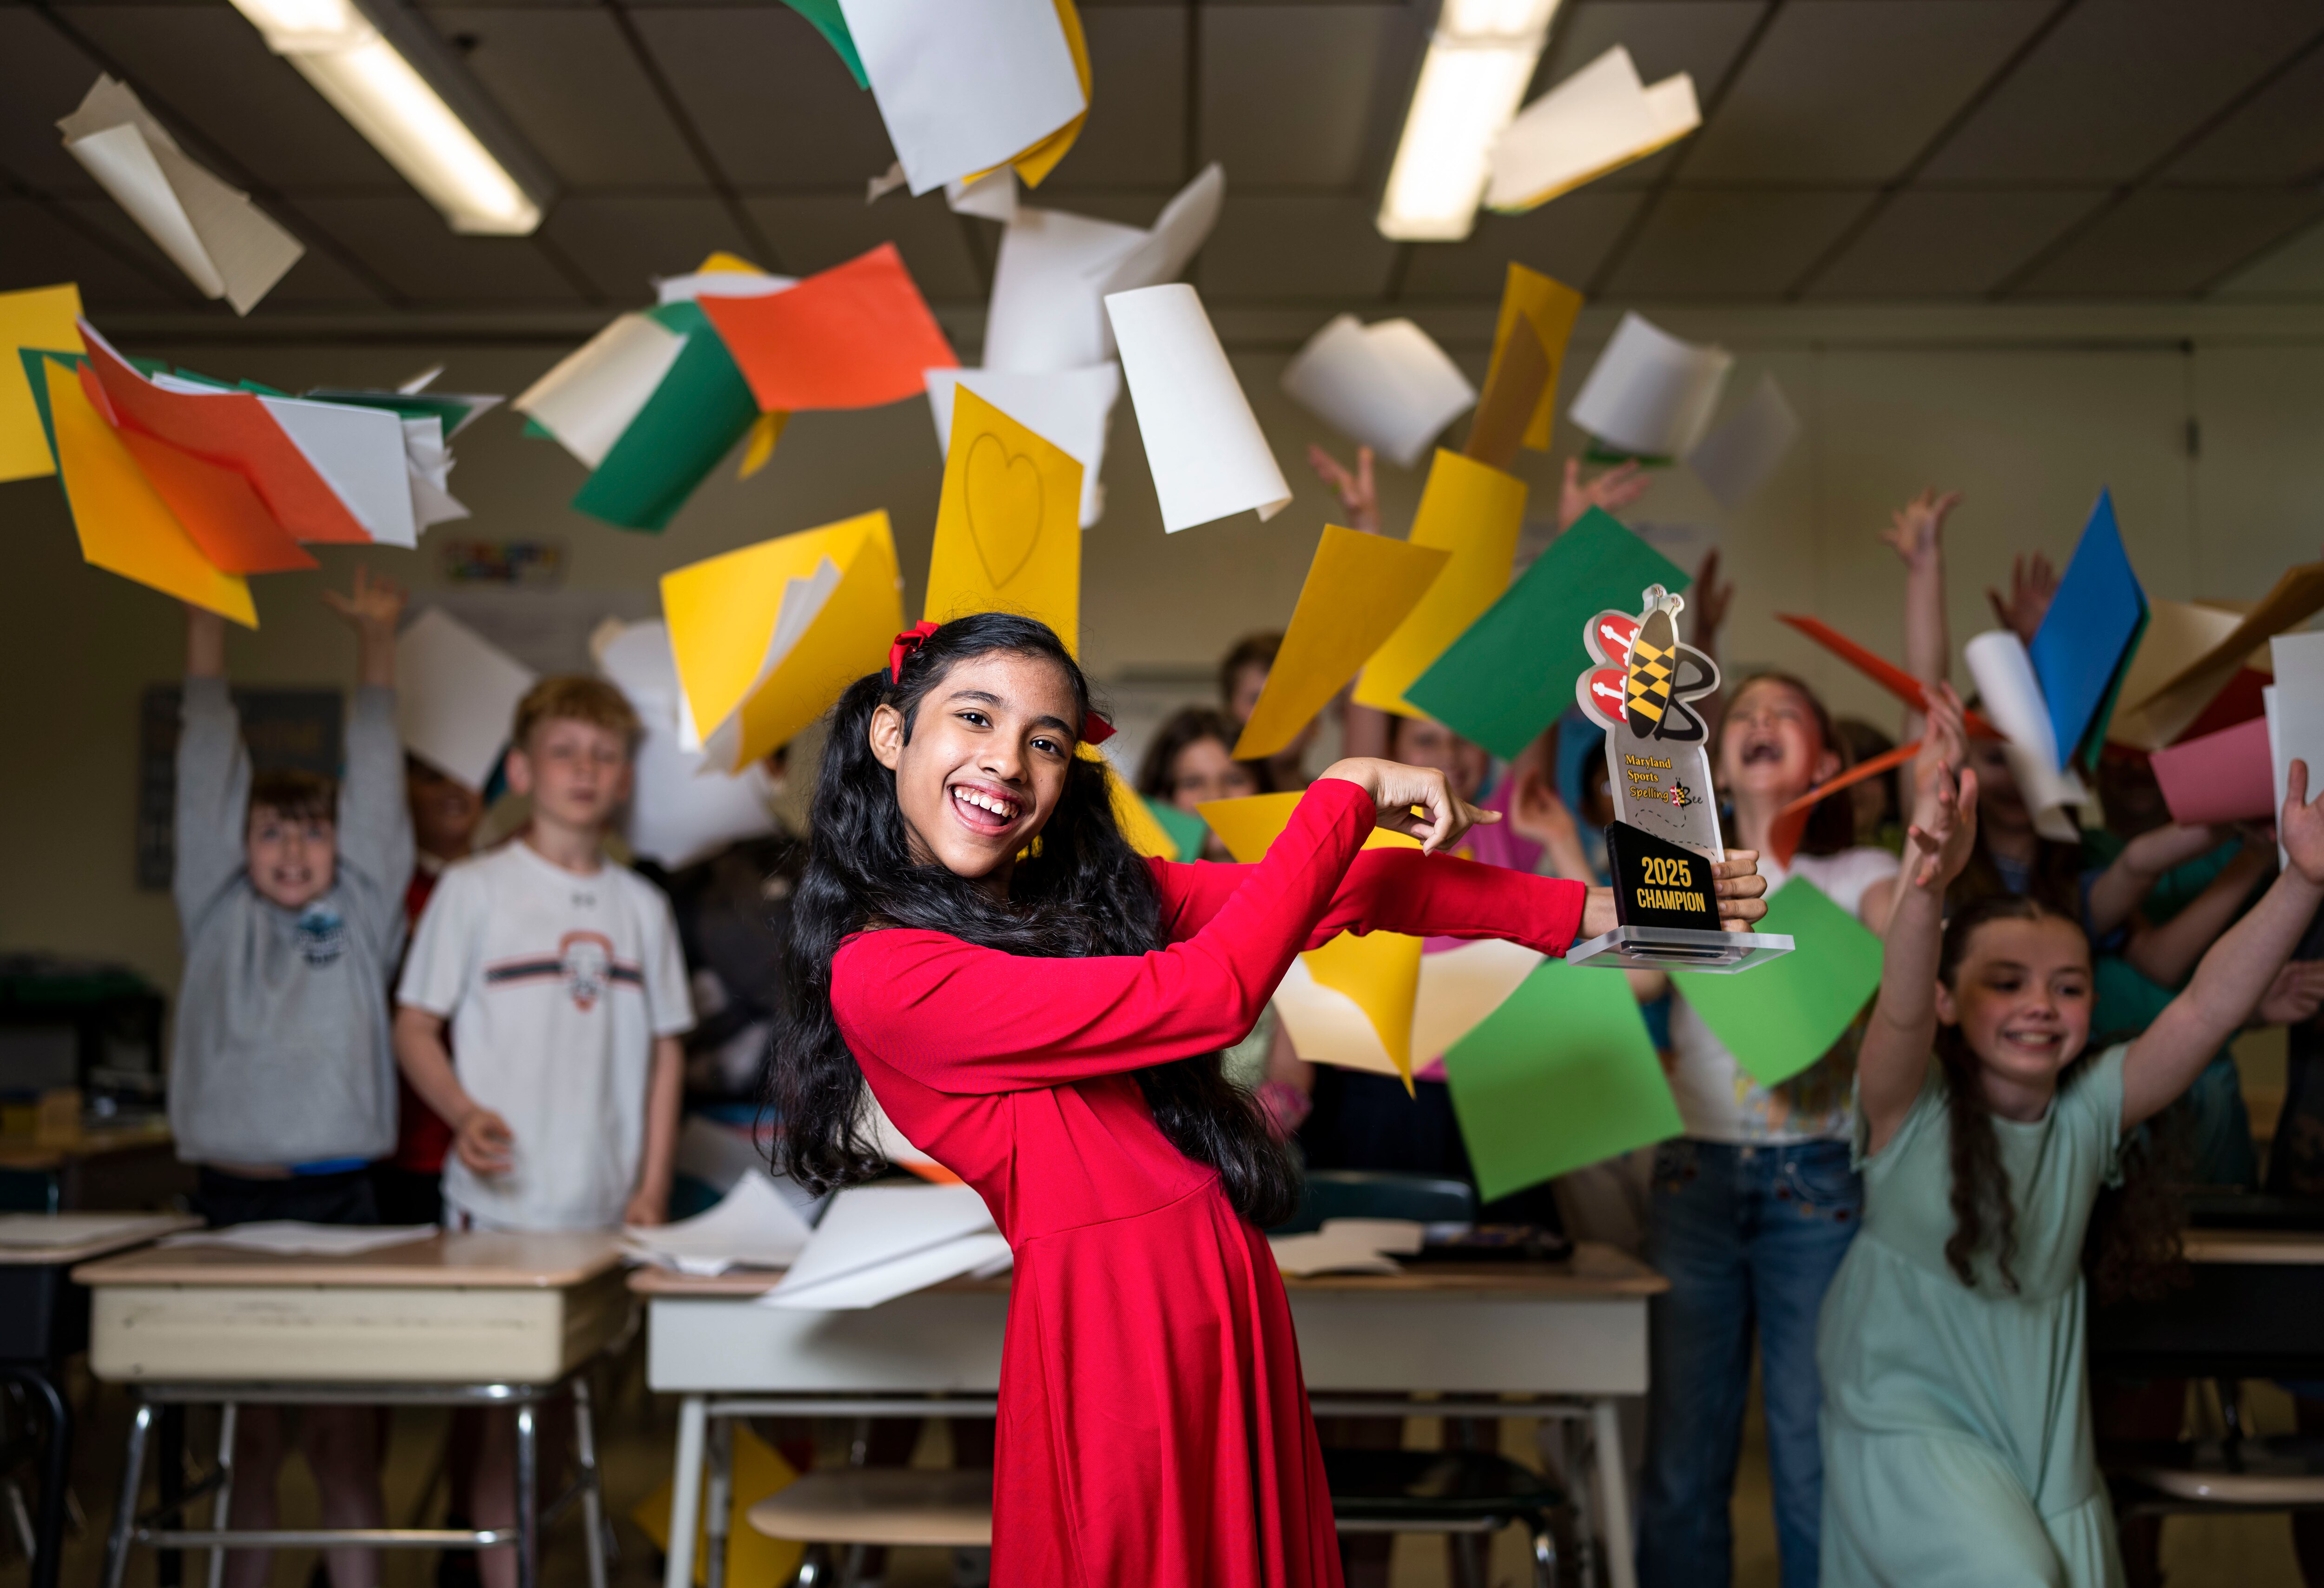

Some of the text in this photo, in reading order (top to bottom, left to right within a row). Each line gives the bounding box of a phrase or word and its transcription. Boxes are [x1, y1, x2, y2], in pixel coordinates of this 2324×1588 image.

[1624, 754, 1672, 770] Maryland
[1627, 769, 1659, 783] Sports
[1630, 786, 1669, 803] Spelling
[1642, 856, 1692, 887] 2025
[1637, 888, 1706, 913] CHAMPION
